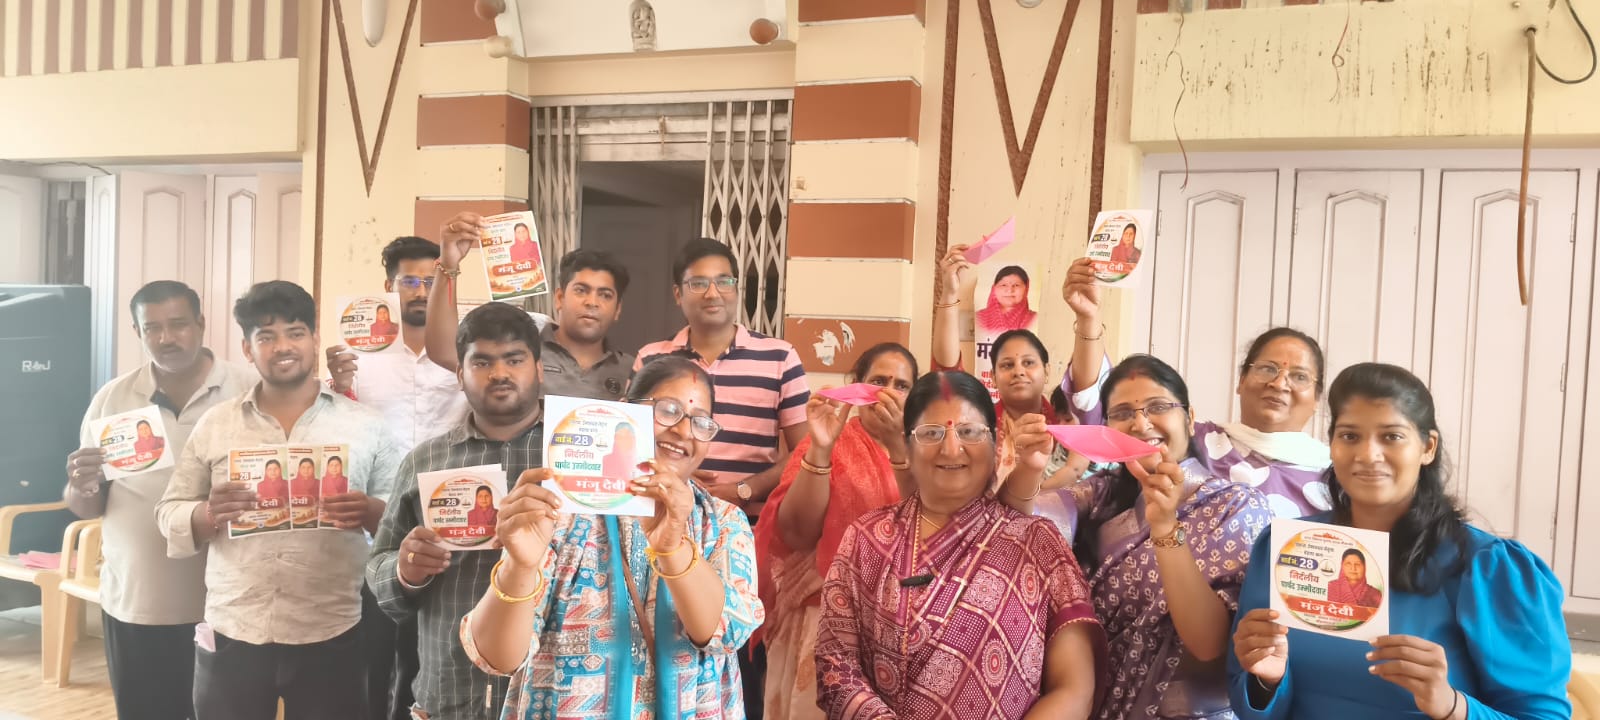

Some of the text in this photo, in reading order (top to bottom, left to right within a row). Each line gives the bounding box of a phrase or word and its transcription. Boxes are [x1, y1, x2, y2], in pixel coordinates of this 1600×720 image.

[516, 261, 531, 271] देवी
[574, 435, 589, 445] 28
[240, 472, 249, 480] 28
[576, 478, 626, 492] मंजू देवी
[261, 497, 278, 507] देवी
[448, 526, 486, 537] मंजू देवी
[1299, 557, 1314, 569] 28
[1289, 569, 1320, 583] निर्दलीय
[1280, 580, 1327, 595] पार्षद उम्मीदवार
[1300, 600, 1354, 617] मंजू देवी
